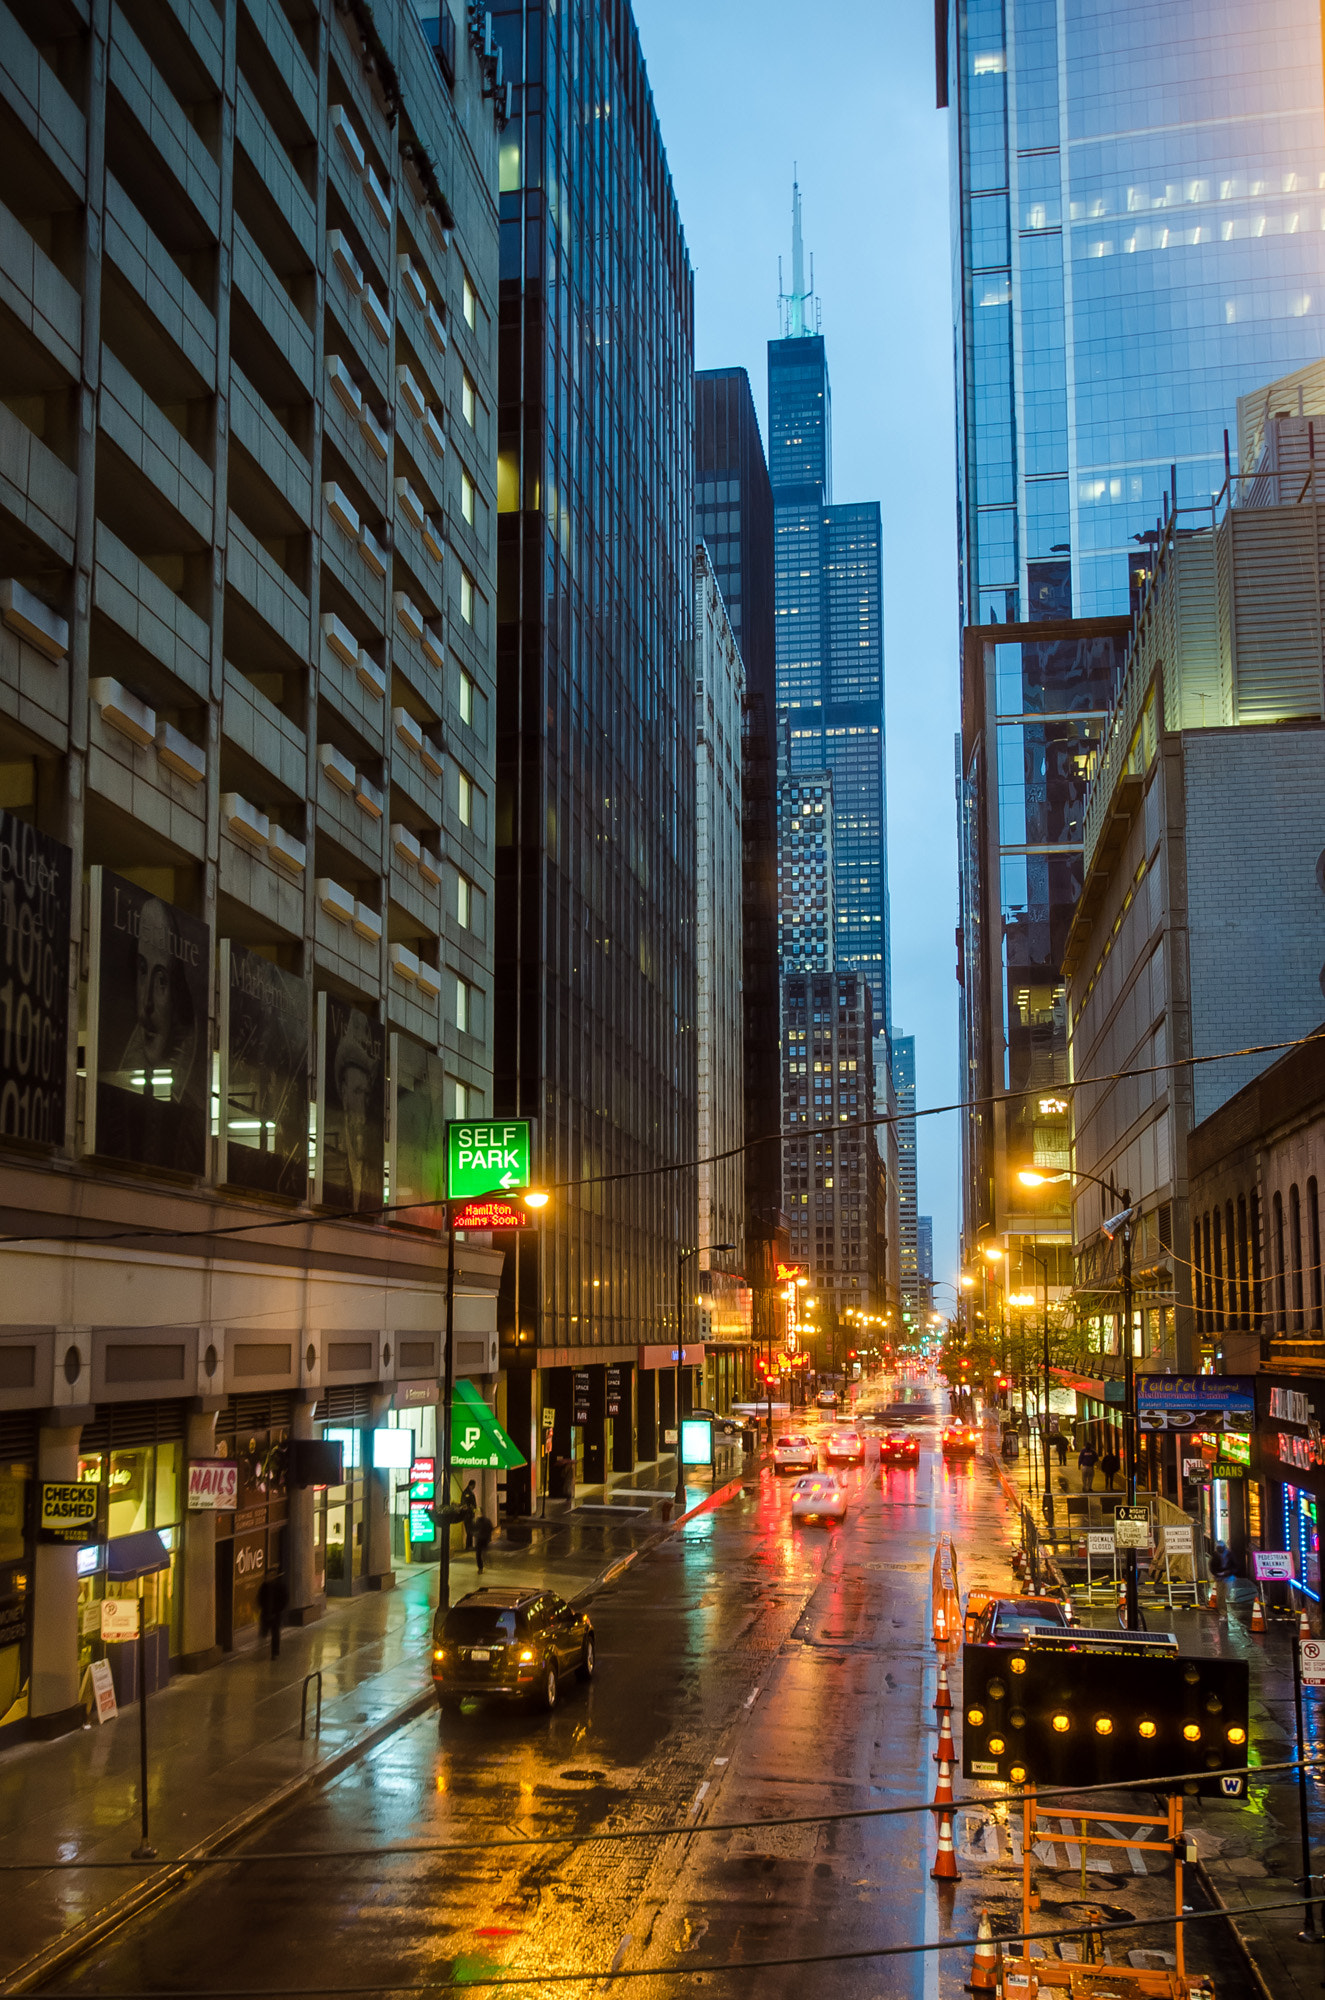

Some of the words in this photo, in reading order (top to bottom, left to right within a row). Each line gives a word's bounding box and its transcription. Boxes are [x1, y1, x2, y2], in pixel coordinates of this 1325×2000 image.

[114, 886, 199, 967] Literature
[458, 1128, 517, 1148] SELF
[458, 1149, 520, 1170] PARK
[465, 1204, 512, 1216] Hamilton
[1139, 1377, 1196, 1392] Falafel
[450, 1456, 488, 1466] Elevators
[1213, 1466, 1243, 1478] LOANS
[190, 1469, 236, 1495] NAILS
[45, 1487, 95, 1502] CHECKS
[45, 1503, 94, 1517] CASHED
[1090, 1535, 1113, 1543] SIDEWALK
[1223, 1779, 1240, 1793] W
